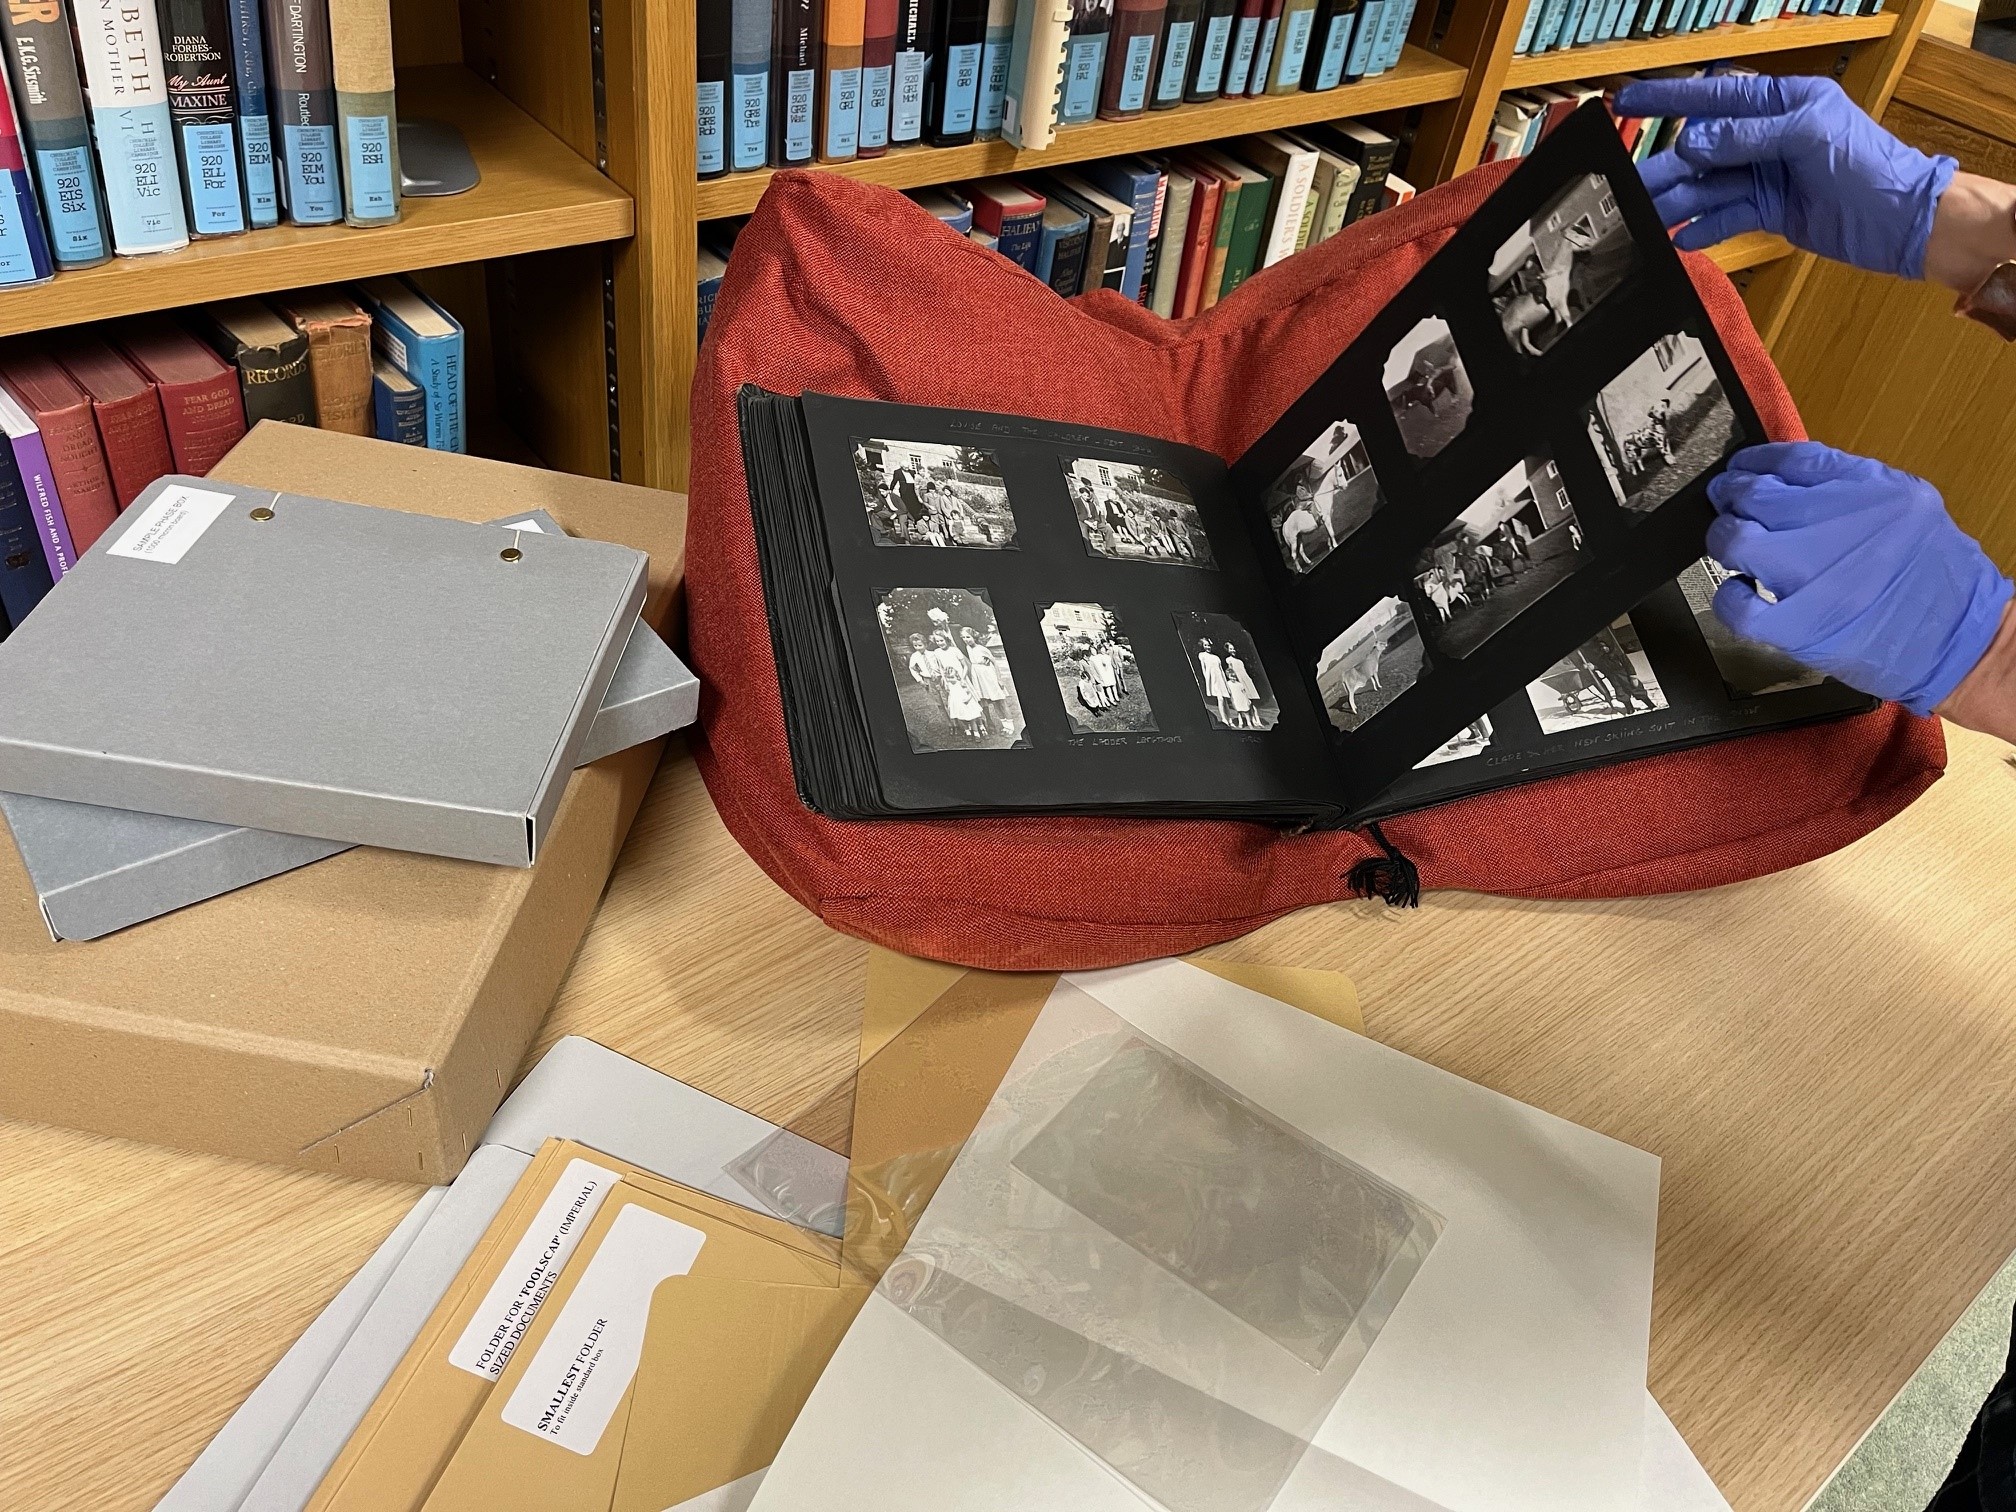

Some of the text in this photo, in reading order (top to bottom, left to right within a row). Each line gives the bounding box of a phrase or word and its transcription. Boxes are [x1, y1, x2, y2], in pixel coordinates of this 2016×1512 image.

[174, 36, 206, 44] DIANA
[290, 5, 307, 73] DARTINGTON
[172, 44, 212, 53] FORBES-
[798, 27, 809, 66] Michael
[103, 20, 125, 95] MOTHER
[165, 52, 221, 61] ROBERTSON
[1078, 63, 1090, 71] 920
[959, 69, 972, 77] 920
[168, 73, 227, 90] My Aunt
[904, 75, 919, 84] 920
[840, 90, 855, 100] 920
[872, 88, 886, 97] 920
[171, 94, 227, 107] MAXINE
[744, 98, 760, 109] 920
[792, 94, 807, 104] 920
[871, 98, 885, 107] GRI
[699, 106, 716, 116] 920
[791, 104, 808, 114] GRE
[839, 101, 854, 110] GRI
[744, 109, 760, 119] GRE
[698, 116, 716, 127] GRE
[699, 127, 716, 136] Rob
[248, 142, 269, 153] 920
[362, 143, 382, 153] 920
[201, 155, 222, 166] 920
[249, 154, 271, 165] ELM
[301, 152, 322, 163] 920
[362, 154, 384, 164] ESH
[134, 163, 157, 174] 920
[202, 167, 225, 178] ELL
[302, 164, 324, 174] ELM
[1299, 164, 1310, 172] A
[57, 177, 80, 189] 920
[135, 174, 158, 186] ELI
[204, 179, 226, 189] For
[303, 175, 325, 185] You
[59, 189, 83, 201] EIS
[137, 186, 161, 197] Vic
[62, 201, 87, 213] Six
[1001, 221, 1040, 236] HALIFA
[446, 355, 458, 389] HEAD
[432, 369, 443, 390] Study
[184, 388, 230, 405] FEAR GOD
[448, 392, 459, 408] OF
[182, 397, 235, 415] AND DREAD
[448, 411, 459, 435] THE
[992, 424, 1010, 434] AND
[33, 474, 49, 507] WILFRED
[43, 508, 55, 526] FISH
[49, 526, 60, 544] AND
[133, 528, 160, 551] SAMPLE
[54, 545, 63, 553] A
[1605, 727, 1645, 742] SKIING
[1649, 721, 1676, 732] SUIT
[1068, 737, 1084, 746] THE
[476, 1181, 598, 1369] FOLDER FOR 'FOOLSCAP' (IMPERIAL)
[490, 1271, 558, 1375] SIZED DOCUMENTS
[537, 1318, 608, 1431] SMALLEST FOLDER
[550, 1348, 604, 1435] To fit inside standard box
